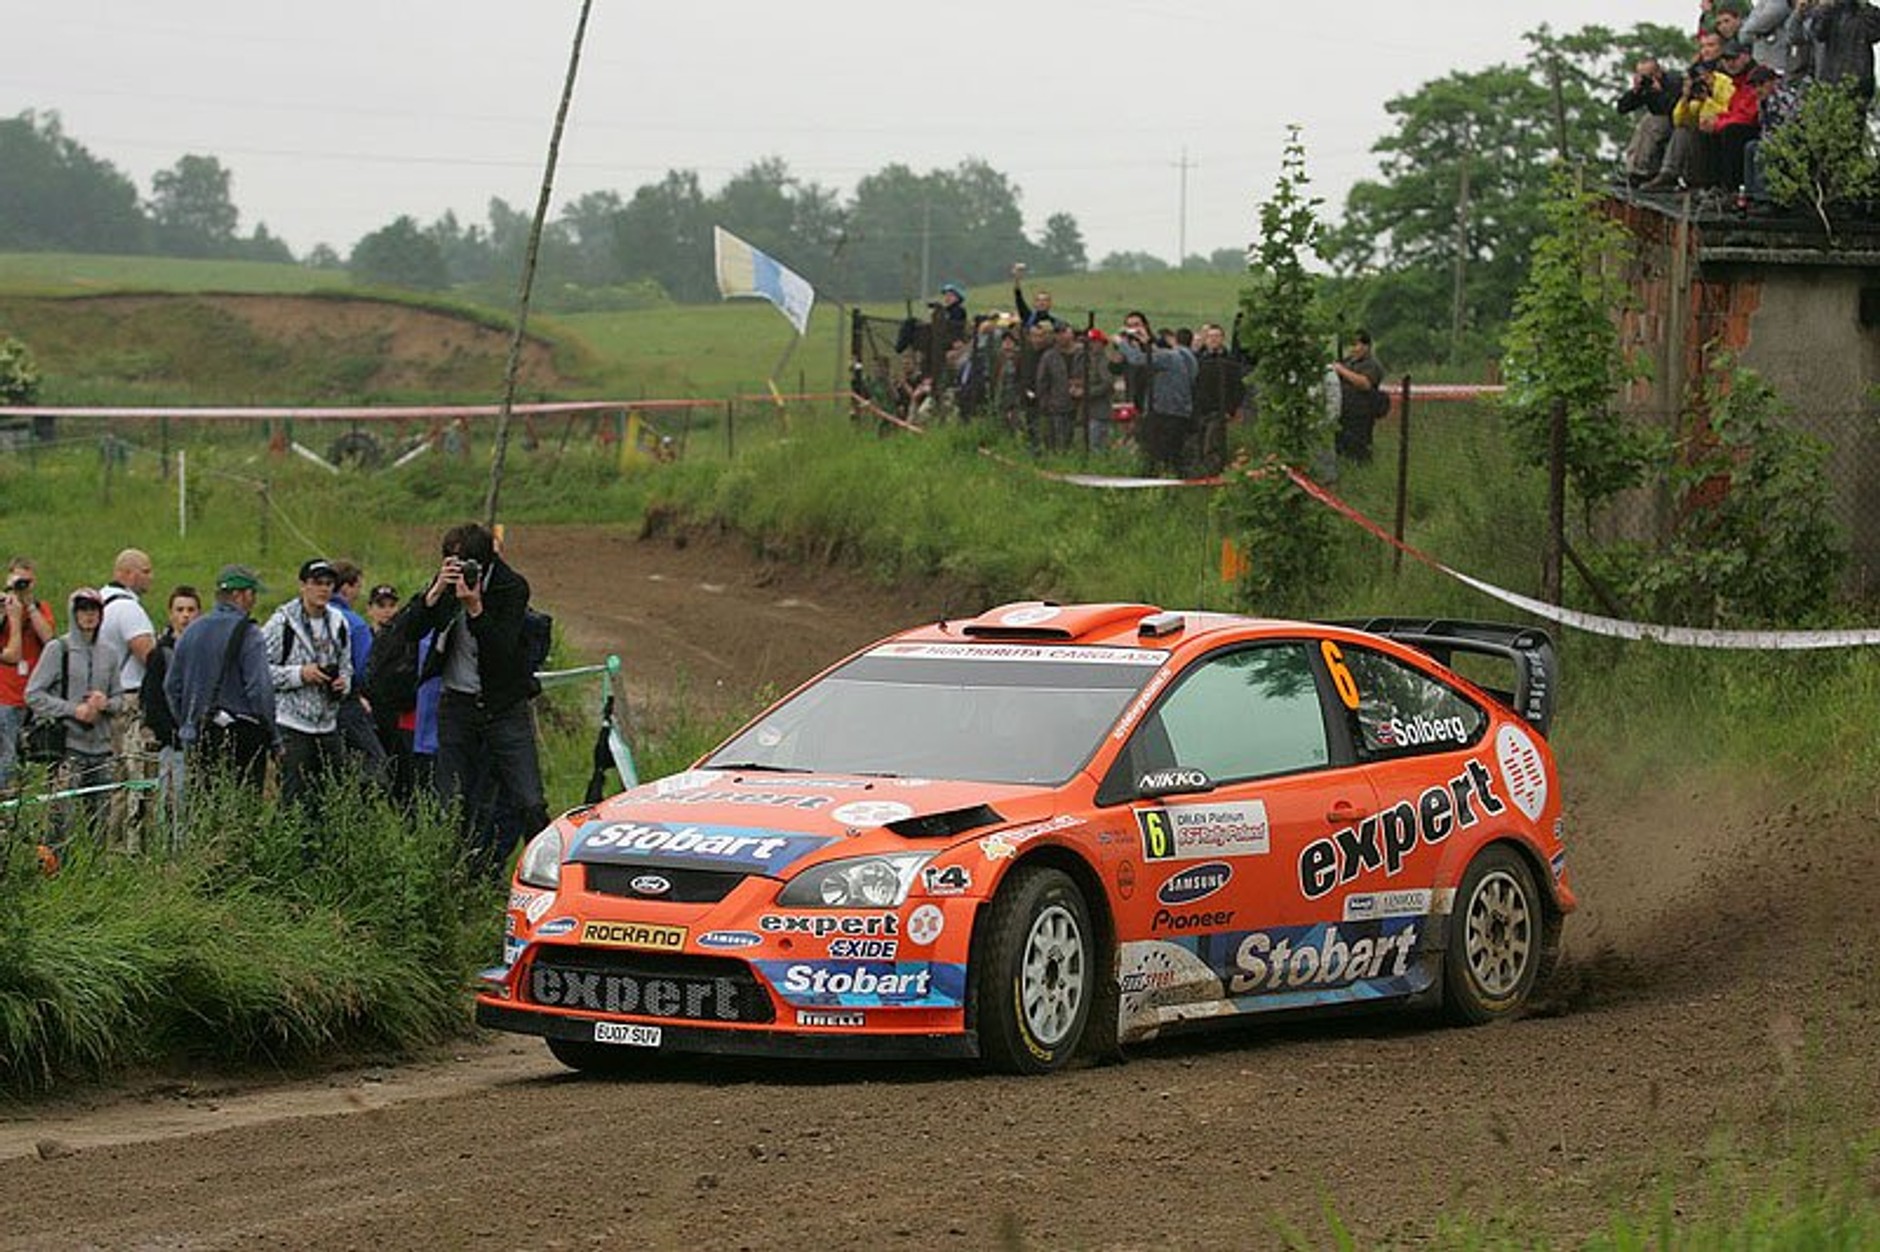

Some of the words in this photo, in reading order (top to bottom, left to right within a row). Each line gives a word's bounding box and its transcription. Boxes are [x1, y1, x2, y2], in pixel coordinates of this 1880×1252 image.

[1320, 639, 1360, 708] 6
[1391, 715, 1468, 747] Solberg
[1139, 772, 1207, 788] NIKKO
[587, 822, 788, 859] Stobart
[1147, 812, 1167, 857] 6
[1298, 758, 1507, 900] expert
[1168, 873, 1225, 892] SAMSUNG
[760, 913, 899, 937] expert
[1152, 909, 1236, 931] Pioneer
[831, 940, 897, 958] EXIDE
[1230, 924, 1417, 994] Stobart
[532, 967, 742, 1020] expert
[784, 964, 931, 995] Stobart
[632, 1028, 660, 1044] SUV
